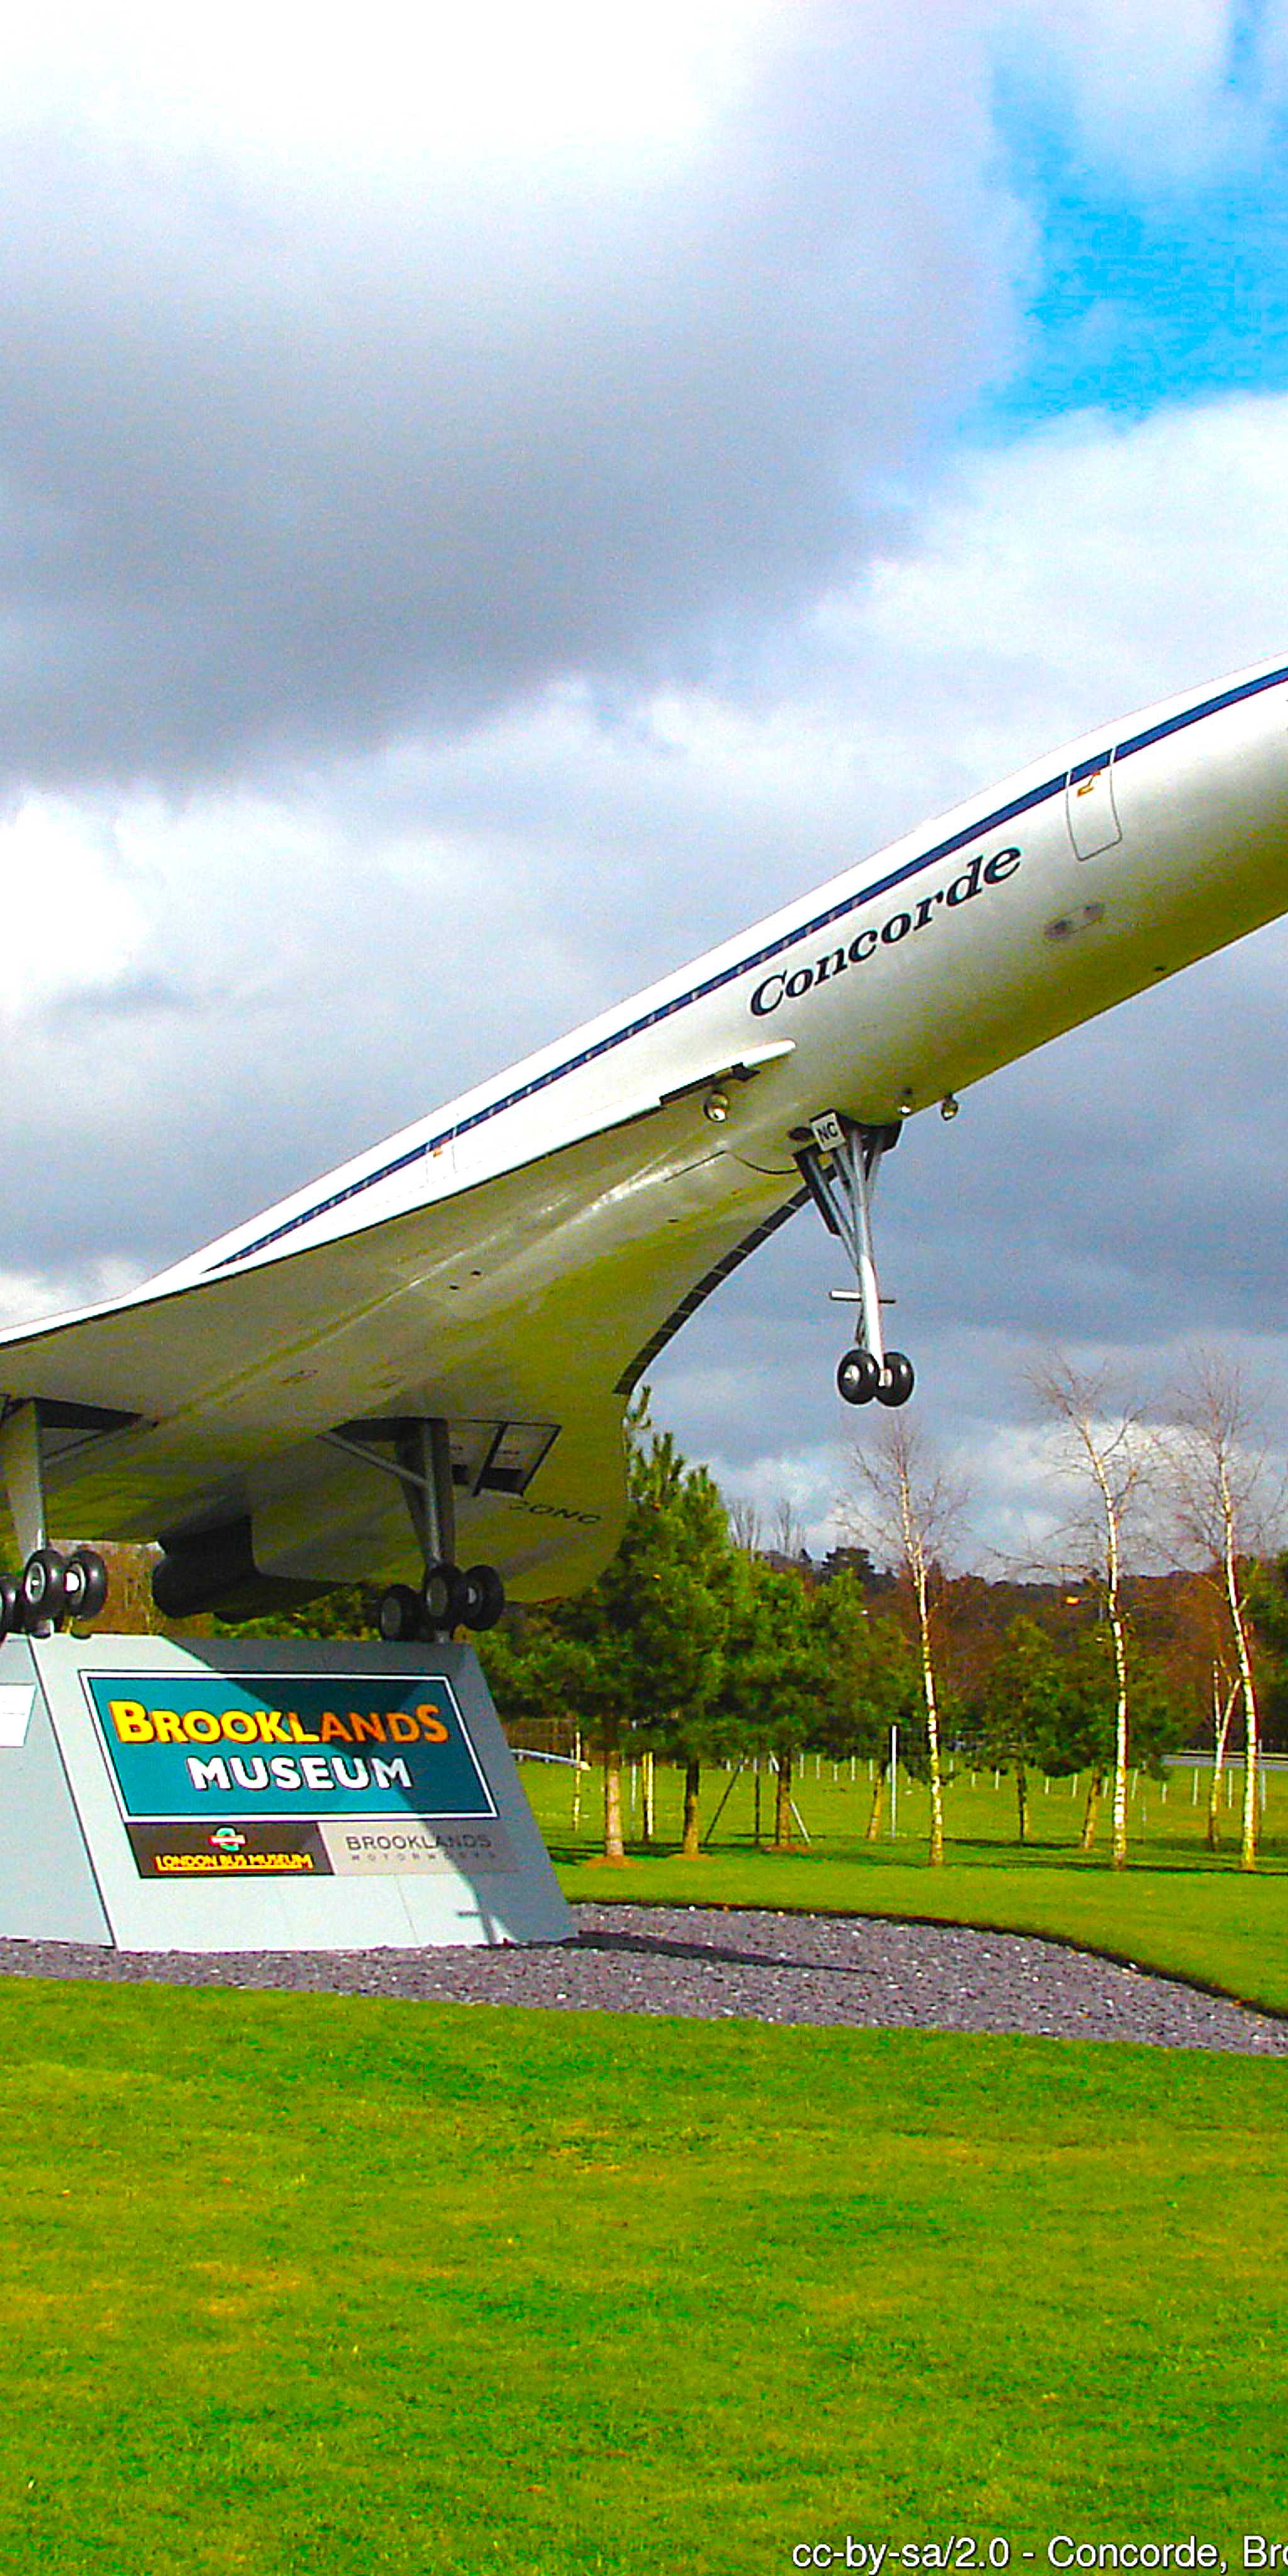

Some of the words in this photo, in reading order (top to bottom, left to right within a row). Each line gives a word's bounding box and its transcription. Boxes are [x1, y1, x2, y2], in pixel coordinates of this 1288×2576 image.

[750, 845, 1021, 1016] Concorde
[817, 1122, 838, 1143] NC
[108, 1700, 449, 1743] BROOKLANDS
[187, 1757, 413, 1790] MUSEUM
[155, 1855, 218, 1872] LONDON
[220, 1855, 247, 1867] BUS
[249, 1854, 313, 1869] MUSEUM
